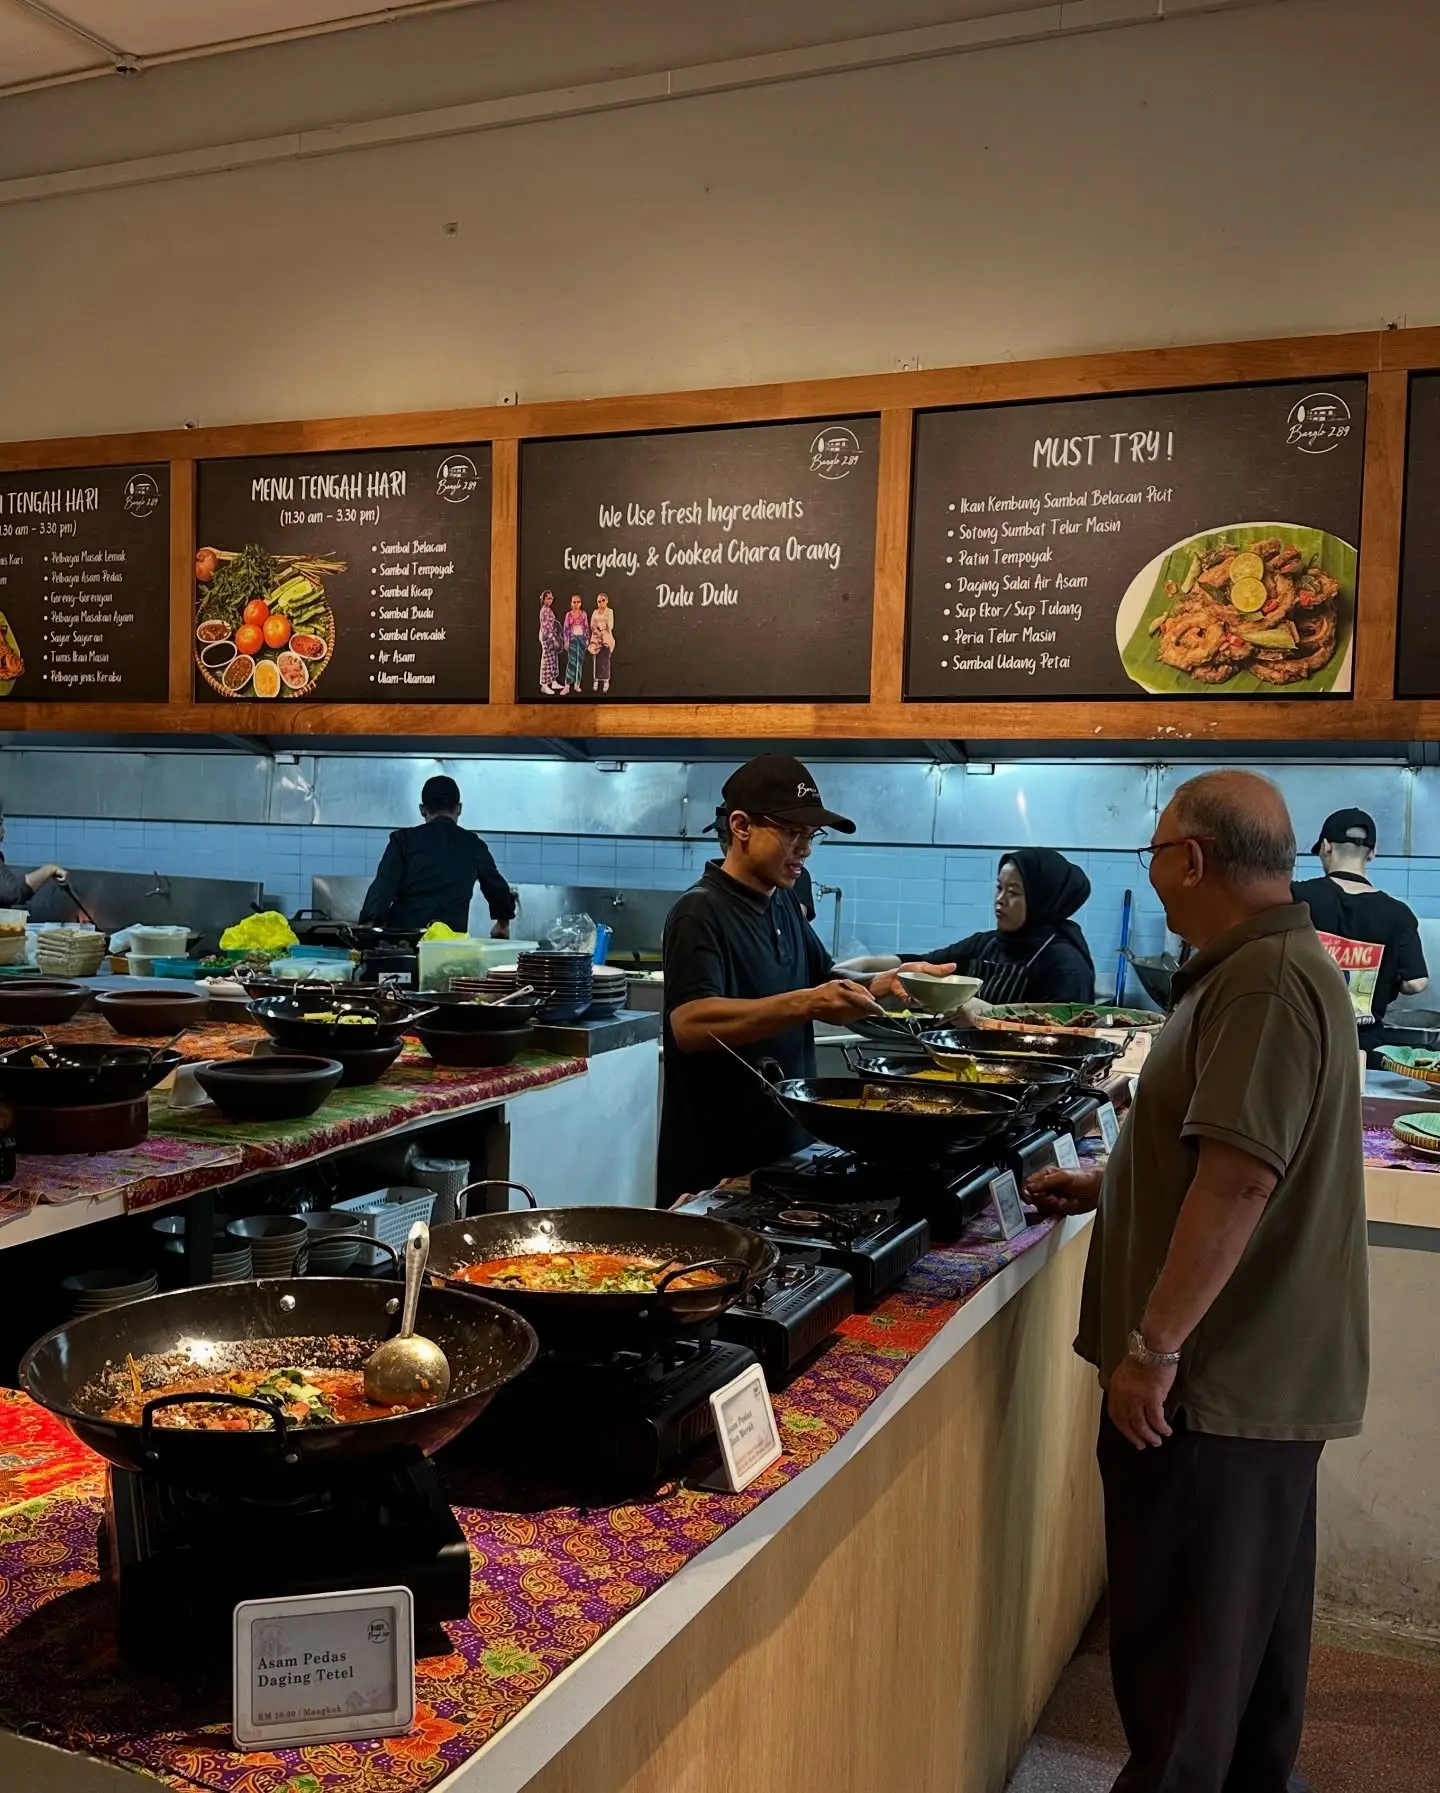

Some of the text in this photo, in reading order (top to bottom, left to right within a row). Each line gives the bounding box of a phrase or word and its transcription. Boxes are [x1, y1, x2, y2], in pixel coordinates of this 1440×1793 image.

[1327, 425, 1350, 438] 289
[841, 454, 859, 466] 289
[1033, 435, 1102, 468] MUST
[252, 470, 407, 502] MENU TENGAH HARI
[8, 490, 61, 515] TENGAH
[66, 487, 99, 512] HARI
[960, 485, 1173, 516] Ikan Kembung Sambal Belacan Picit
[307, 511, 323, 523] am
[336, 508, 357, 523] 3.30
[360, 505, 380, 526] pm)
[599, 497, 804, 532] We Use Fresh Ingredients
[15, 525, 29, 536] am
[39, 522, 57, 535] 3.30
[60, 520, 77, 537] pm)
[959, 516, 1121, 544] Sotong Sumbat Telur Masin
[380, 539, 447, 554] Sambal Belacan
[646, 546, 659, 567] &
[665, 541, 722, 566] Cooked
[727, 539, 781, 564] Chara
[785, 536, 841, 570] Orang
[958, 546, 1053, 568] Patin Tempoyak
[81, 571, 101, 583] Asam
[102, 570, 123, 582] Pedas
[379, 560, 455, 579] Sambal Tempoyak
[379, 583, 434, 600] Sambal Kicap
[656, 582, 739, 608] Dulu Dulu
[957, 573, 1088, 598] Daging Salai Air Asam
[379, 605, 434, 619] Sambal Budu
[955, 603, 976, 622] Sup
[1040, 600, 1082, 621] Tulang
[378, 627, 409, 641] Sambal
[955, 627, 1056, 645] Peria Telur Masin
[392, 649, 416, 664] Asam
[952, 652, 1071, 675] Sambal Udang Petai
[257, 1651, 347, 1670] Asam Pedas
[257, 1666, 355, 1688] Daging Tetel
